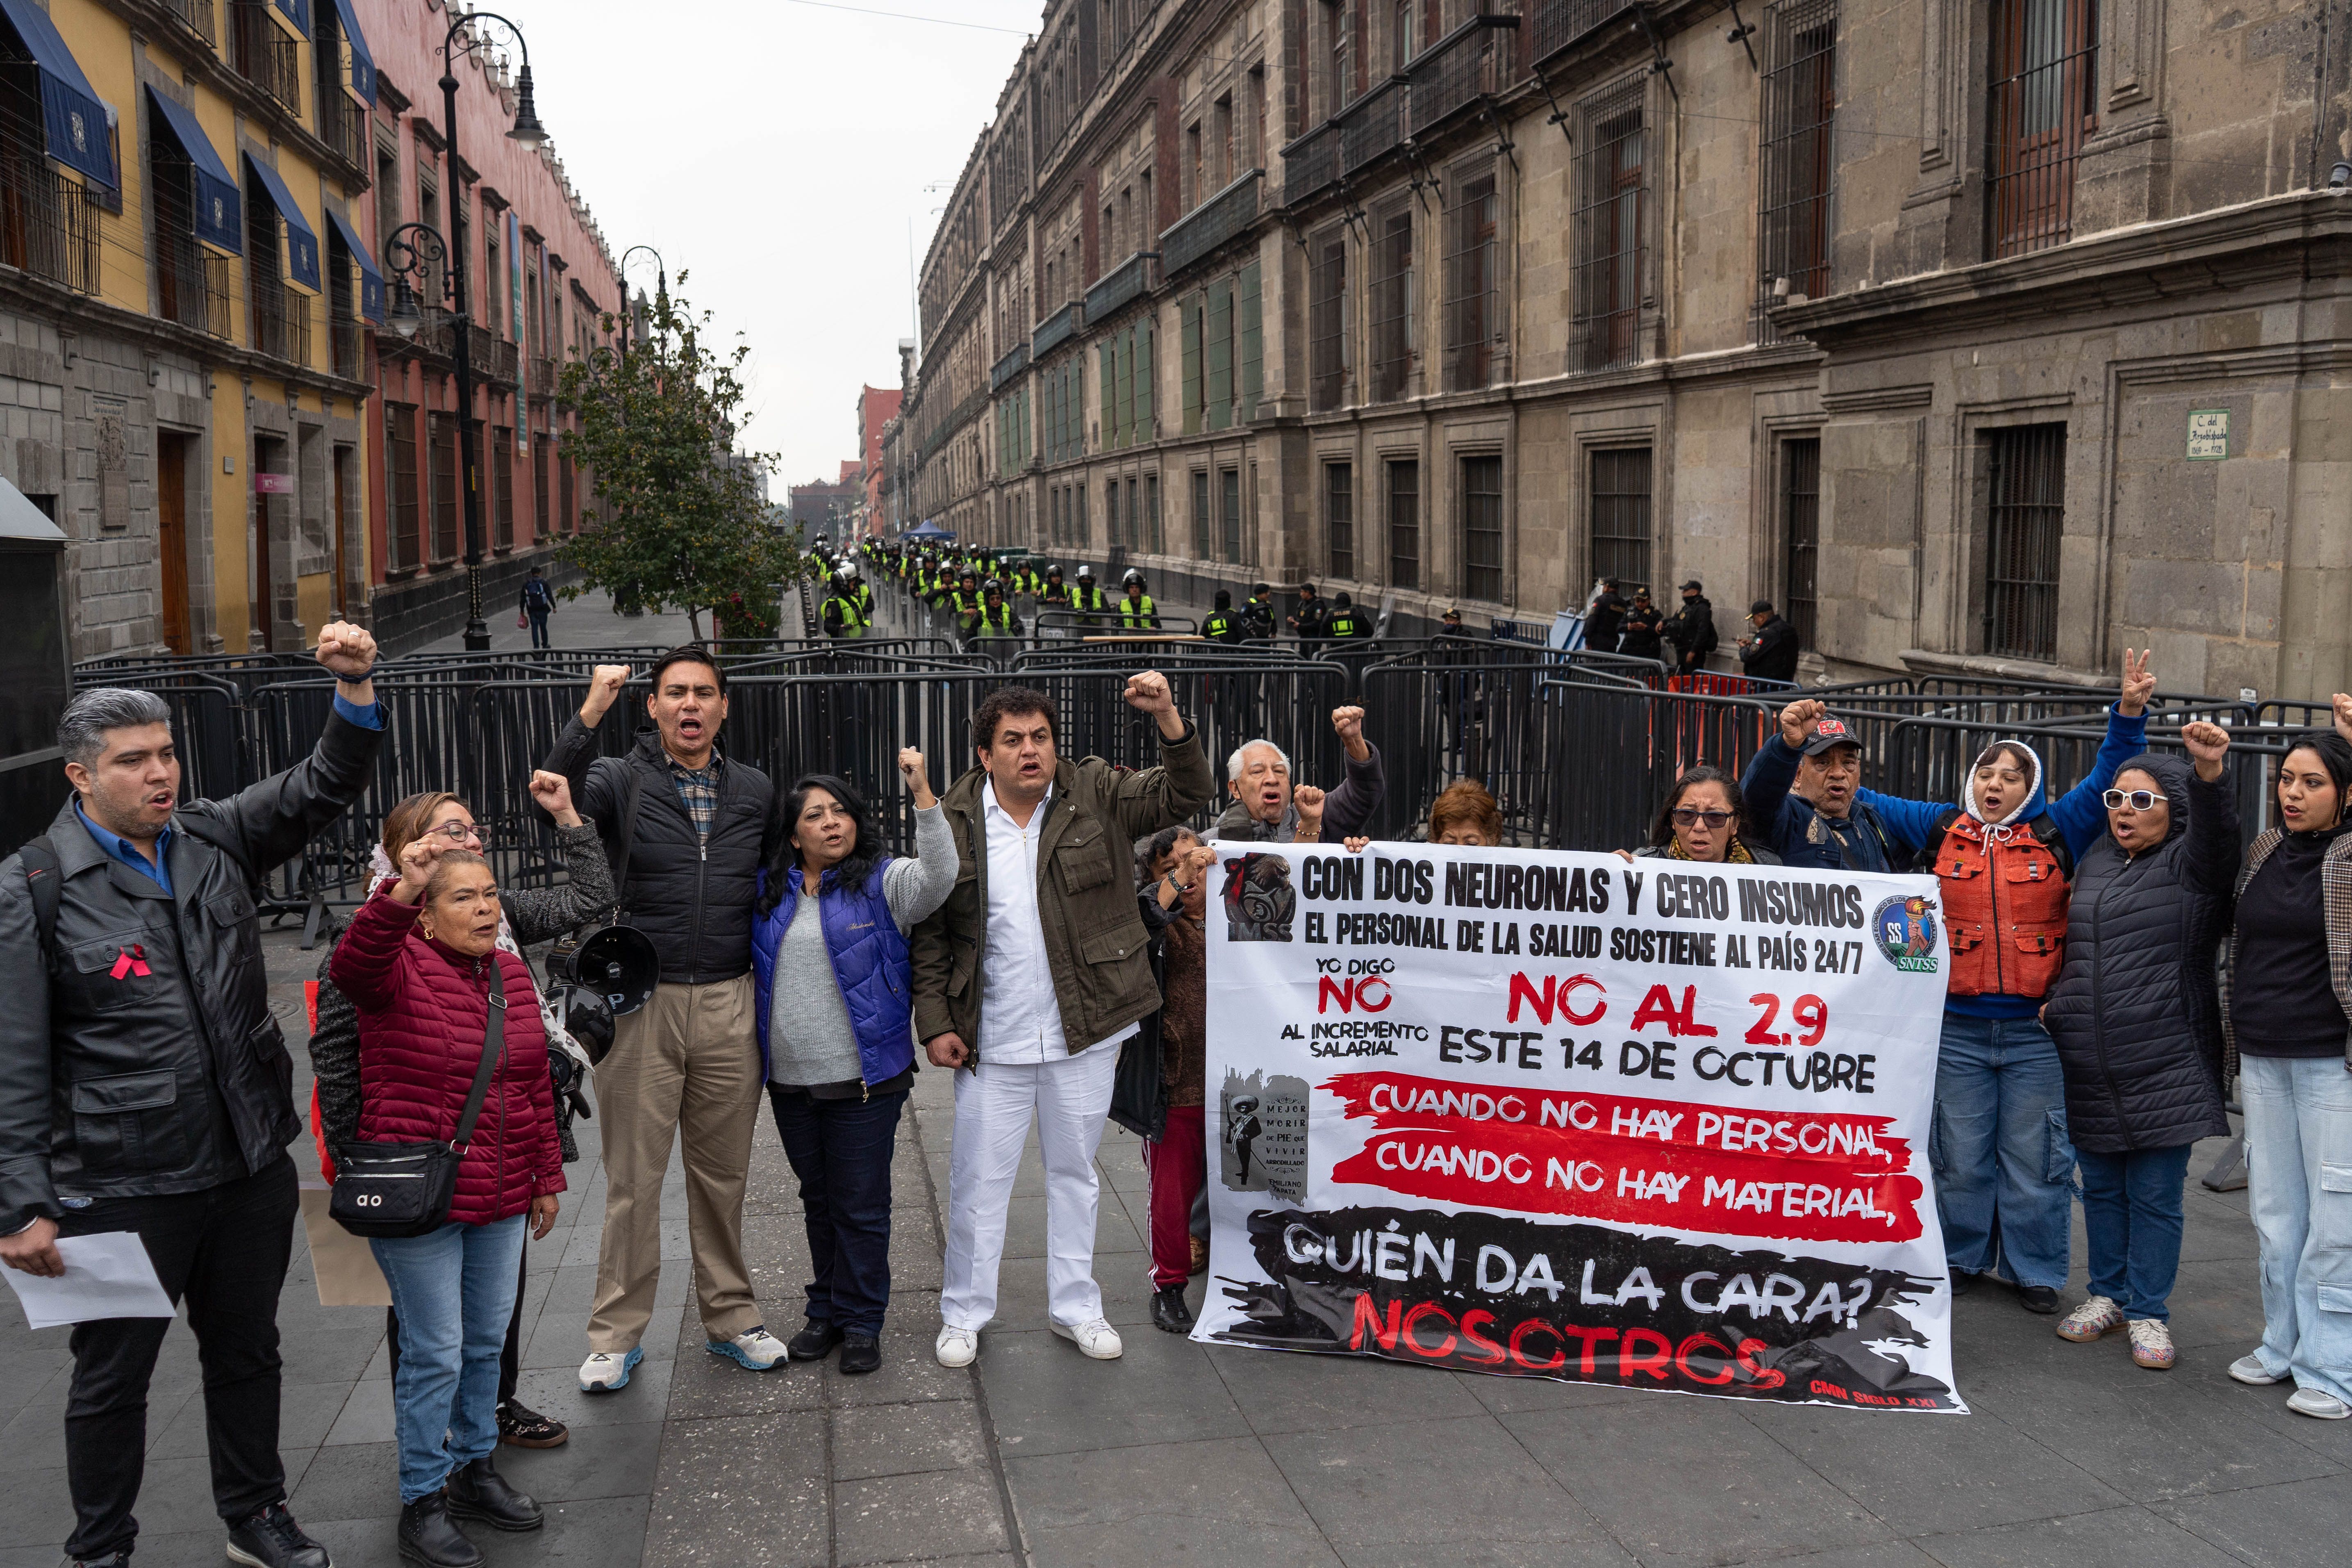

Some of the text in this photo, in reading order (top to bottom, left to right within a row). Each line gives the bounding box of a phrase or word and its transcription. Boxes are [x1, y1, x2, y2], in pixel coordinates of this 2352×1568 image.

[2208, 414, 2217, 426] del
[2190, 428, 2227, 444] Arzobispado
[1303, 855, 1864, 929] CON DOS NEURONAS Y CERO INSUMOS
[1228, 922, 1293, 942] IMSS
[1875, 933, 1895, 961] BIENESTAR
[1922, 912, 1936, 957] TRABAJADORES
[1887, 922, 1902, 944] SS
[1305, 912, 1863, 974] EL PERSONAL DE LA SALUD SOSTIENE AL PAÍS 24/7
[1316, 958, 1395, 975] YO DIGO
[1899, 957, 1938, 972] SNTSS
[1318, 975, 1392, 1014] NO
[1507, 971, 1827, 1046] NO AL 2.9
[1281, 1022, 1428, 1042] AL INCREMENTO
[1310, 1040, 1398, 1058] SALARIAL
[1440, 1026, 1876, 1094] ESTE 14 DE OCTUBRE
[1267, 1105, 1306, 1113] MEJOR
[1267, 1119, 1306, 1127] MORIR
[1369, 1083, 1892, 1164] CUANDO NO HAY PERSONAL,
[1277, 1133, 1291, 1142] PIE
[1268, 1179, 1301, 1188] EMILIANO
[1272, 1185, 1296, 1195] ZAPATA
[1376, 1141, 1895, 1227] CUANDO NO HAY MATERIAL,
[1283, 1219, 1873, 1330] QUIÉN DA LA CARA?
[1350, 1291, 1786, 1389] NOSOTROS
[1810, 1380, 1938, 1408] CMN SIGLO XXI
